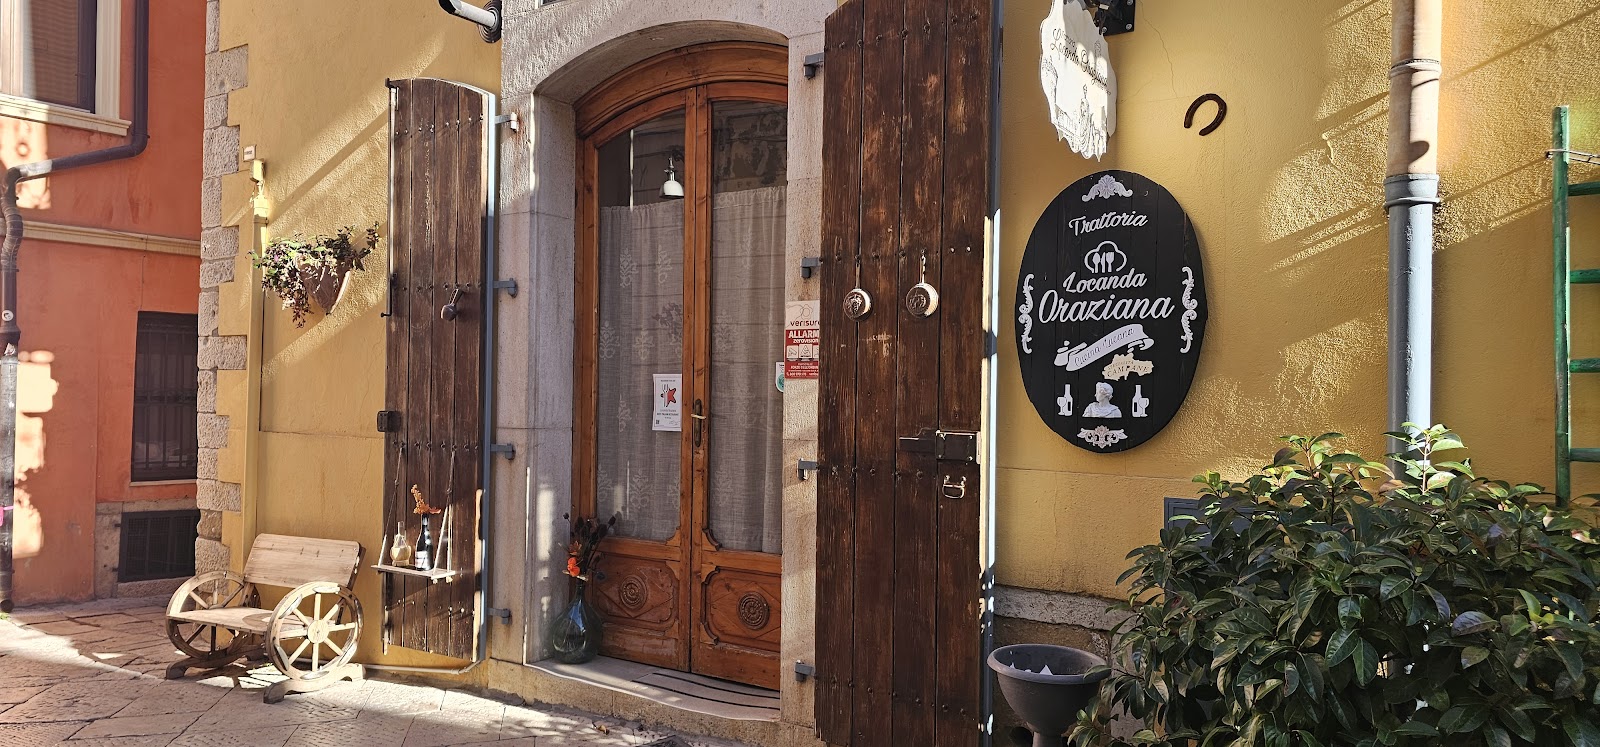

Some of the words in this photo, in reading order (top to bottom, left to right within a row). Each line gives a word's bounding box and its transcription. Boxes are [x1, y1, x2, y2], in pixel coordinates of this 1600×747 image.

[1068, 210, 1149, 236] Trattoria
[1062, 267, 1148, 293] Locanda
[1038, 289, 1176, 323] Oraziana
[788, 330, 820, 339] ALLARM
[1074, 346, 1101, 367] Cucina
